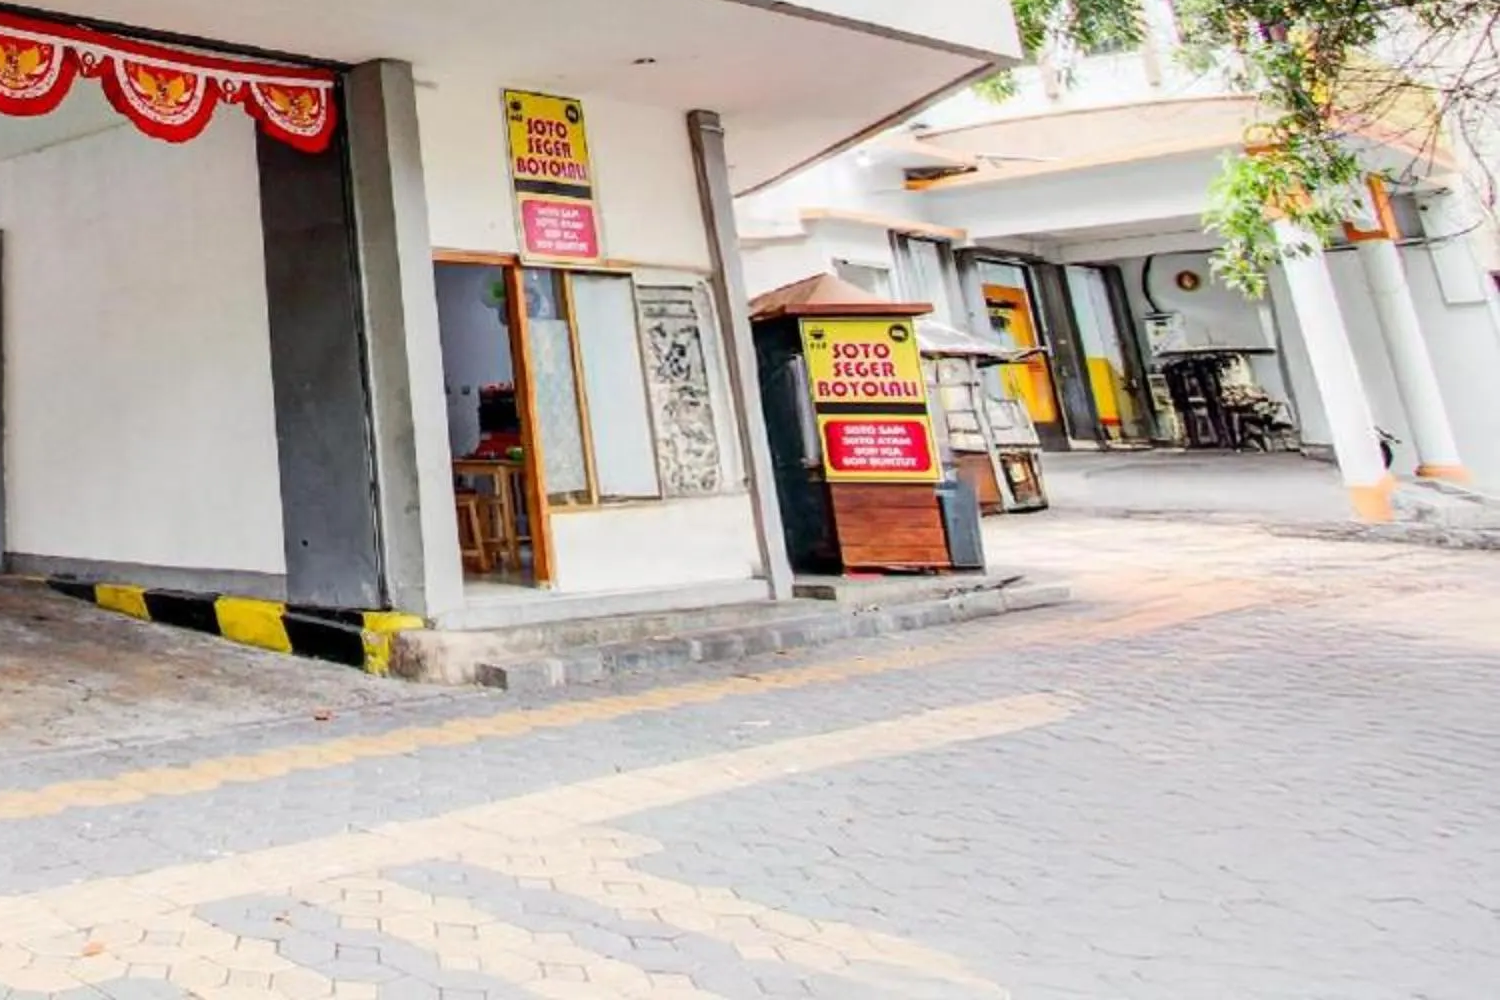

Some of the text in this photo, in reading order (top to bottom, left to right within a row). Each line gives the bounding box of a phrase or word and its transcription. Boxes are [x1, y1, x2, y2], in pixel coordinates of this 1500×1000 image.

[526, 117, 567, 138] SOTO
[527, 138, 571, 158] SEGER
[832, 343, 890, 359] SOTO
[833, 361, 896, 377] SEGER
[817, 381, 918, 397] BOYOLALI
